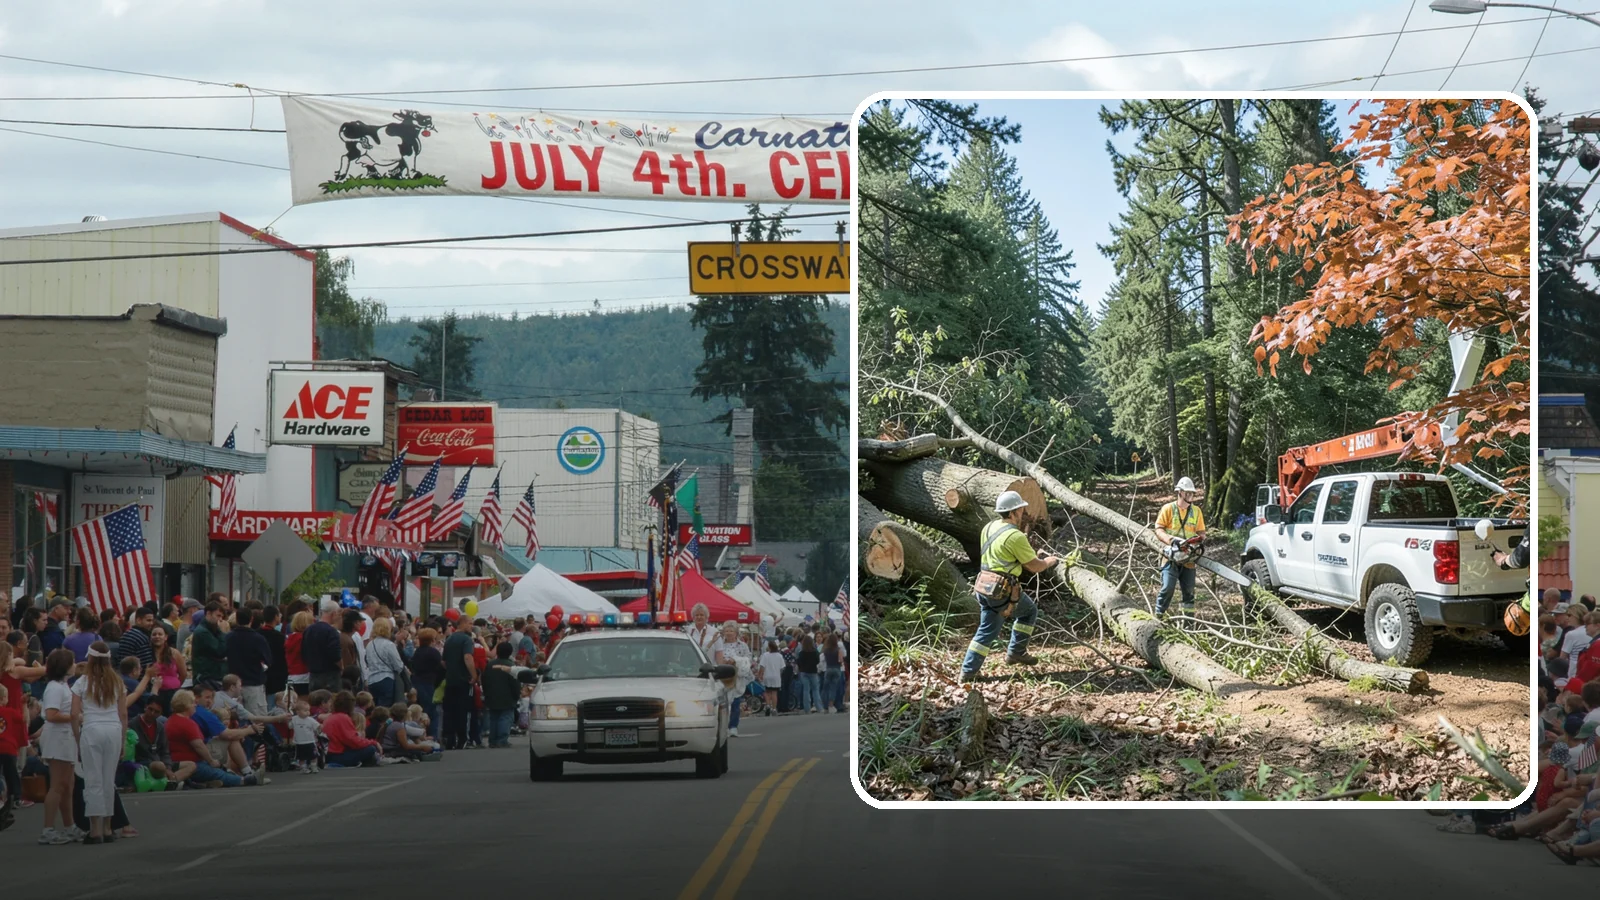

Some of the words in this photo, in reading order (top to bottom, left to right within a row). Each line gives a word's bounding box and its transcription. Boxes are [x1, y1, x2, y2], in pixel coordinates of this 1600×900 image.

[481, 141, 605, 192] JULY
[632, 150, 746, 198] 4th.
[697, 254, 850, 280] CROSSWA
[282, 380, 373, 420] ACE
[405, 409, 452, 422] CEDAR
[283, 421, 370, 436] Hardware
[416, 428, 477, 447] Coca-Cola
[353, 467, 386, 479] Simpl
[95, 485, 124, 495] Vincent
[126, 486, 135, 495] de
[137, 486, 155, 495] Paul
[212, 516, 330, 536] HARDARE
[688, 526, 741, 535] CRNATION
[699, 535, 730, 543] GLASS
